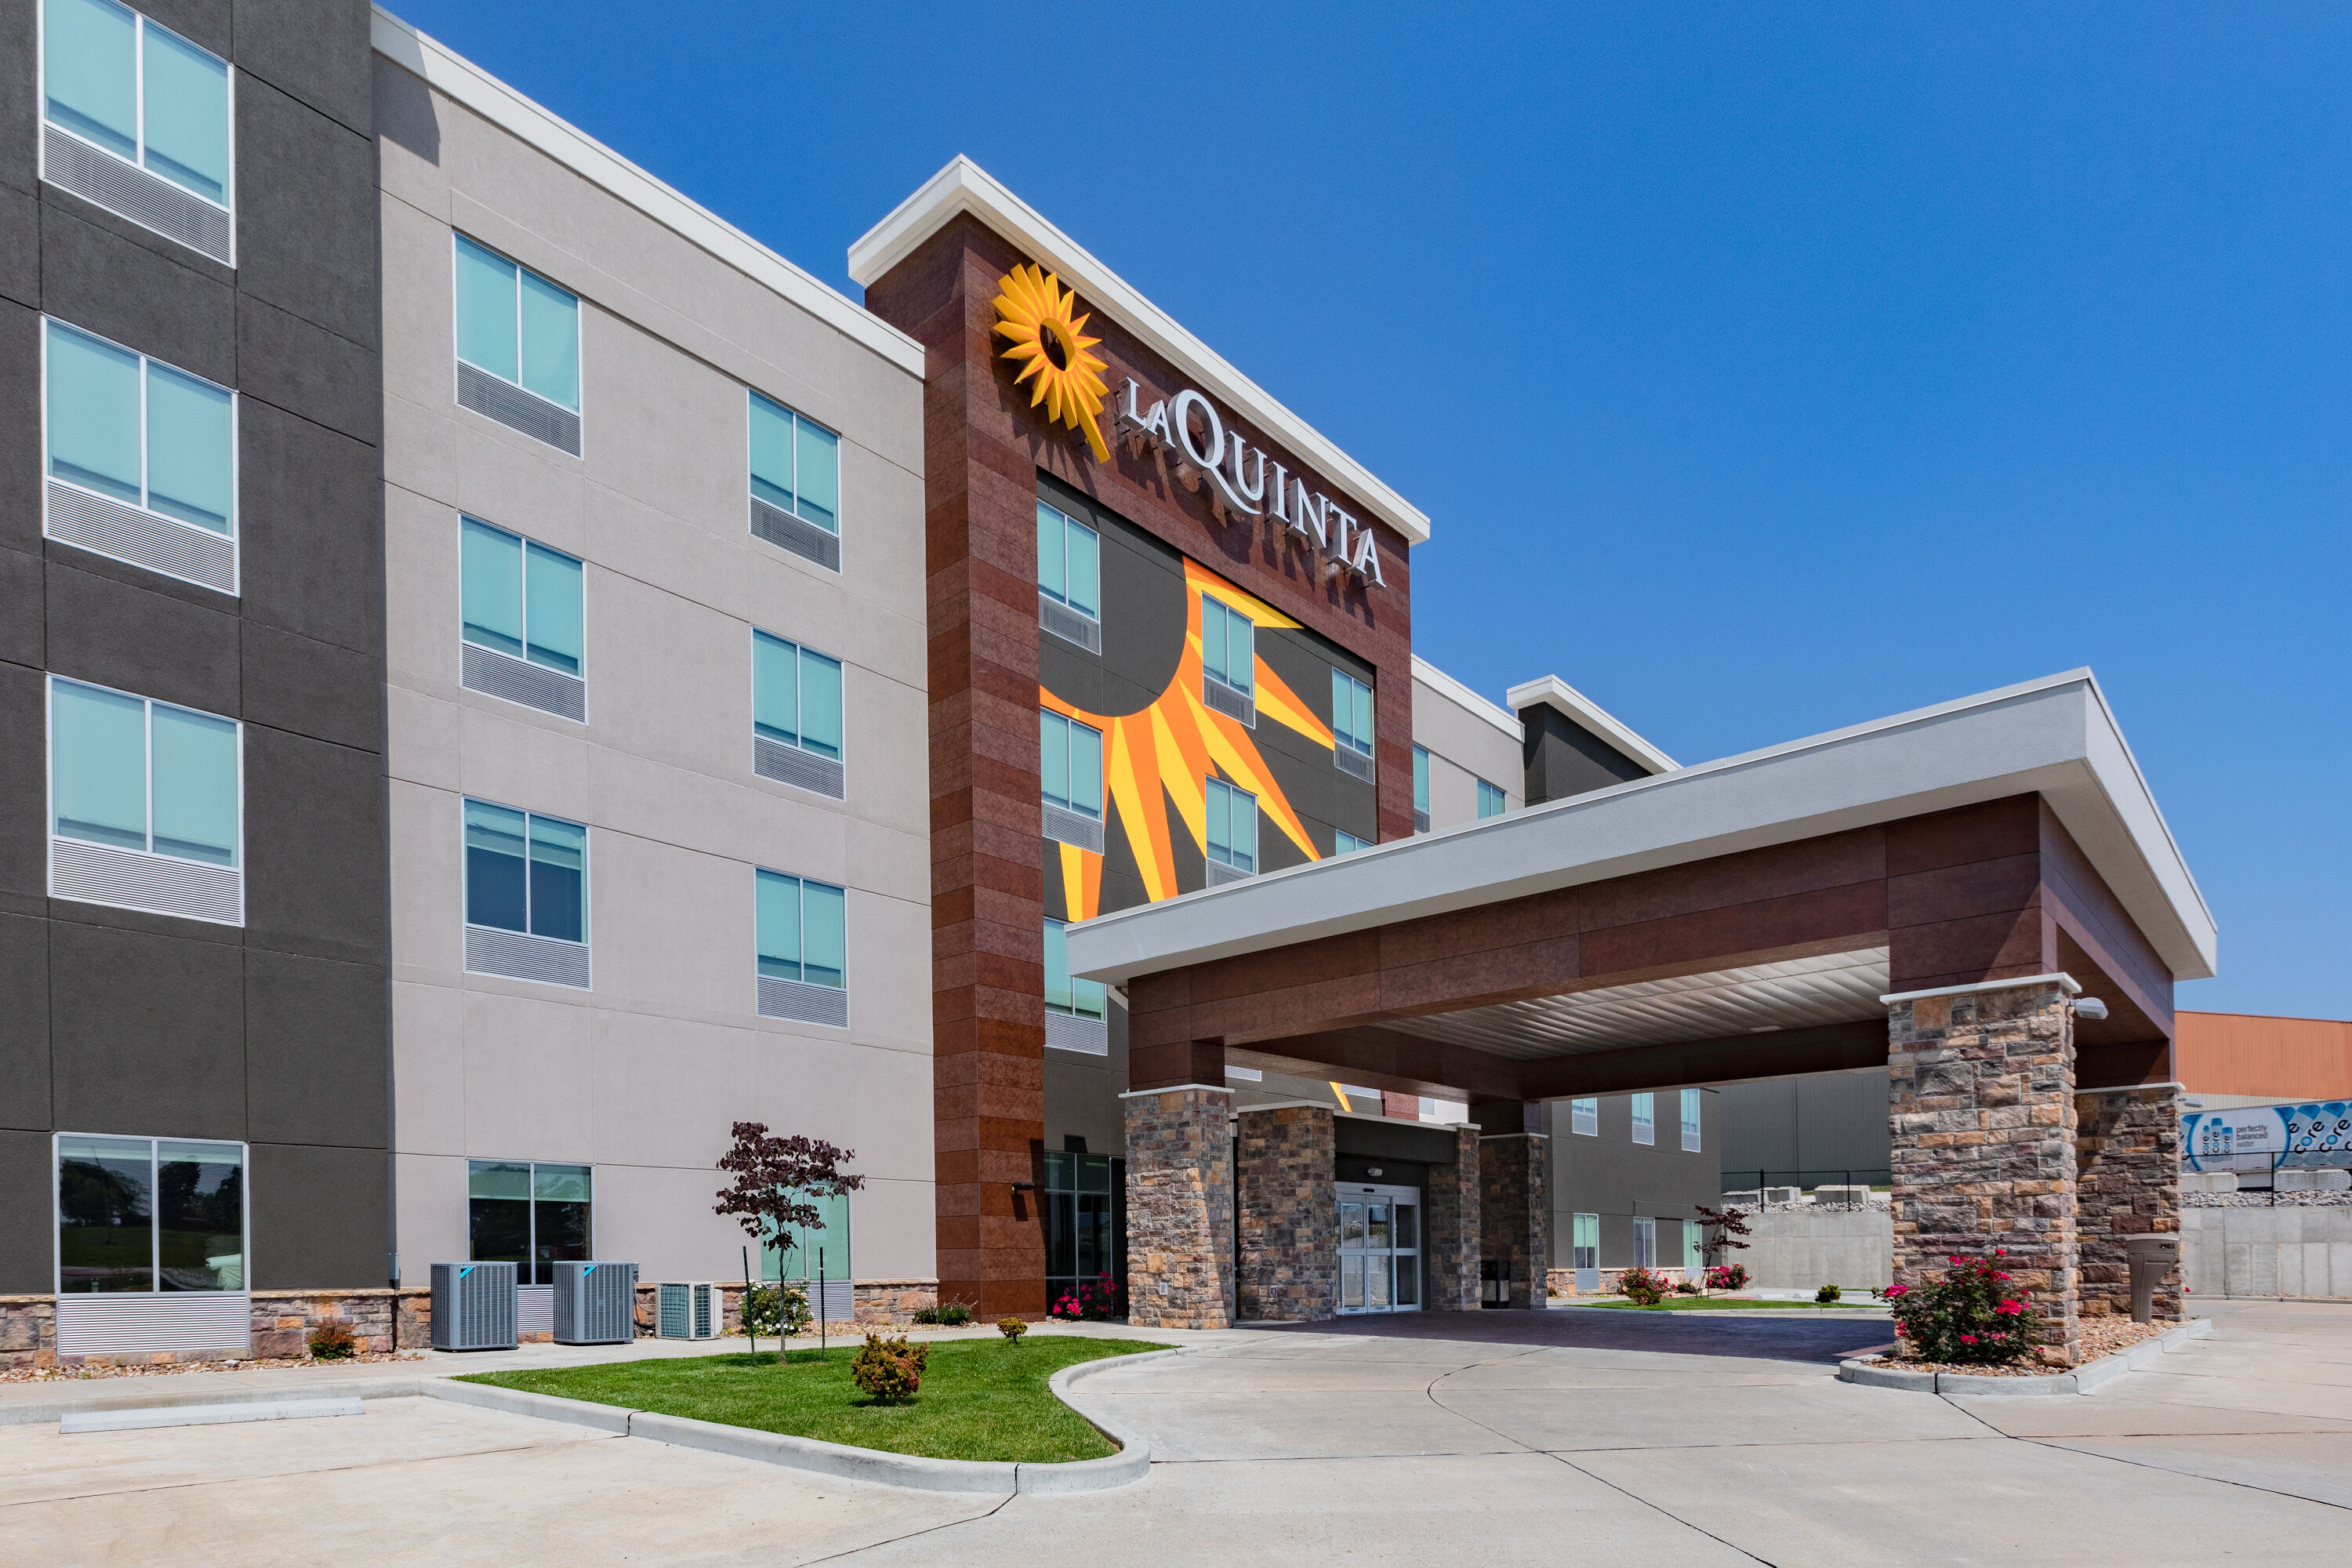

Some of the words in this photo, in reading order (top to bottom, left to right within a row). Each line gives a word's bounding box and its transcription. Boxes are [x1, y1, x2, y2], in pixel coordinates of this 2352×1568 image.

[2236, 1124, 2267, 1134] perfectly
[2236, 1132, 2268, 1141] balanced
[2294, 1121, 2325, 1154] core
[2319, 1120, 2350, 1152] core
